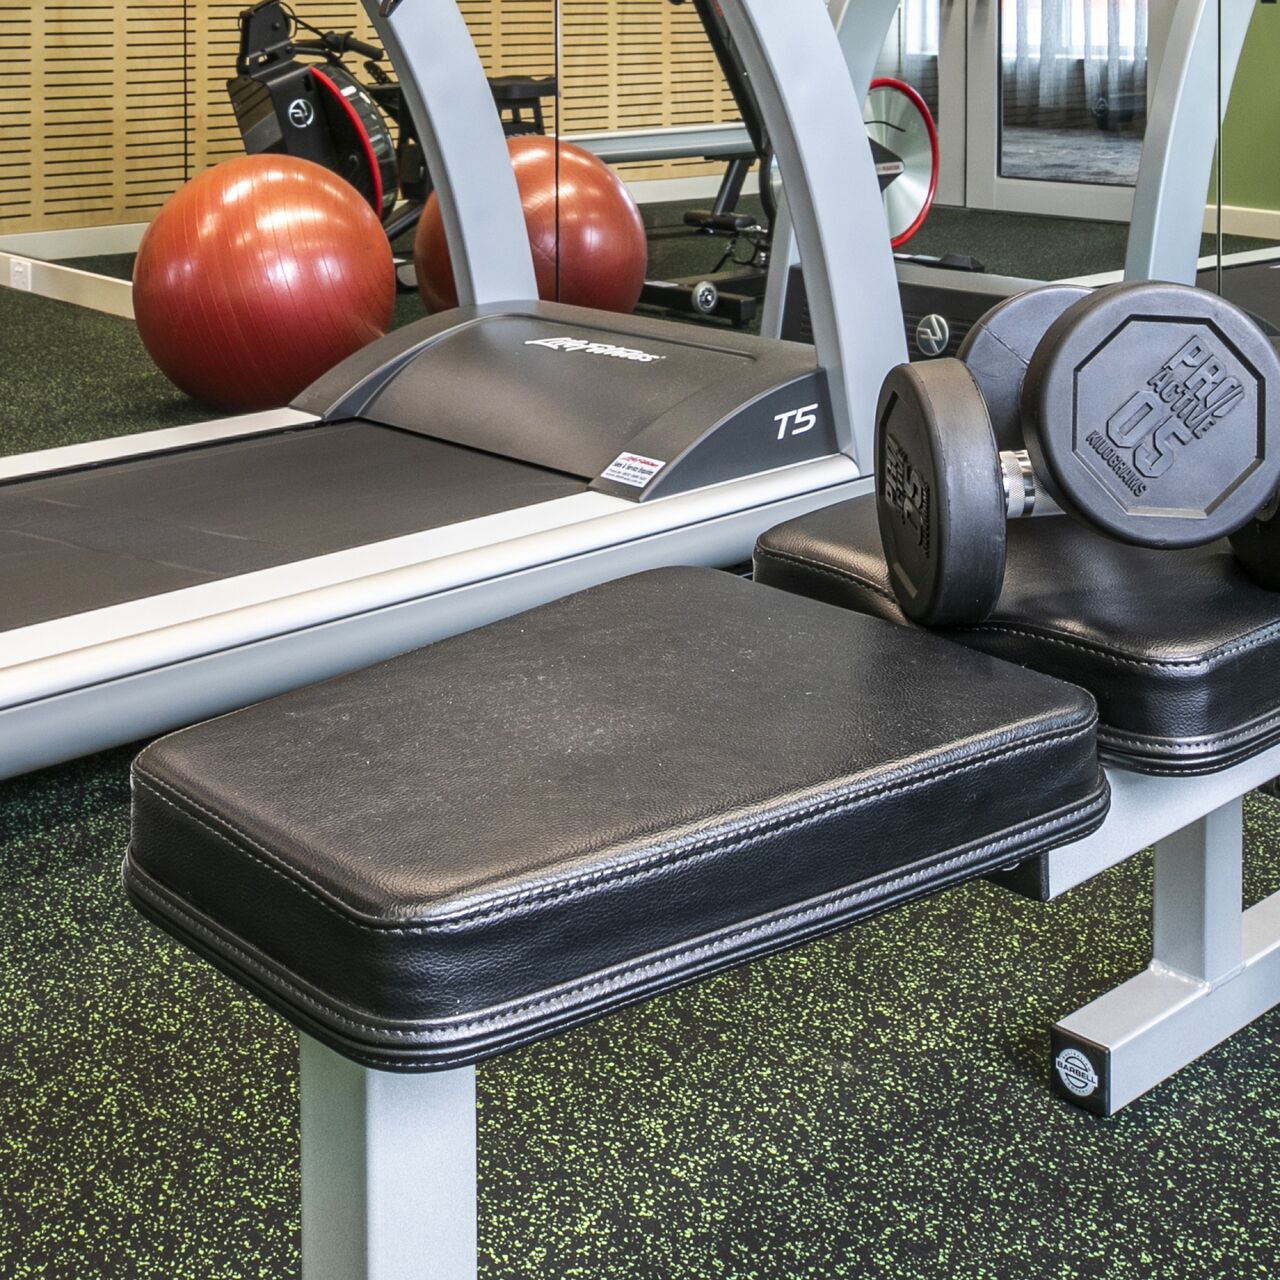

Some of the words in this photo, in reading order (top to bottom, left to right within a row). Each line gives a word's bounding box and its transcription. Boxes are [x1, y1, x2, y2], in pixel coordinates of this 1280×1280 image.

[1146, 364, 1218, 440] ACTIVE
[1161, 334, 1245, 419] PRO
[773, 402, 819, 440] T5
[1085, 429, 1148, 498] KILOGRAMS
[1056, 1059, 1097, 1085] BARBELL
